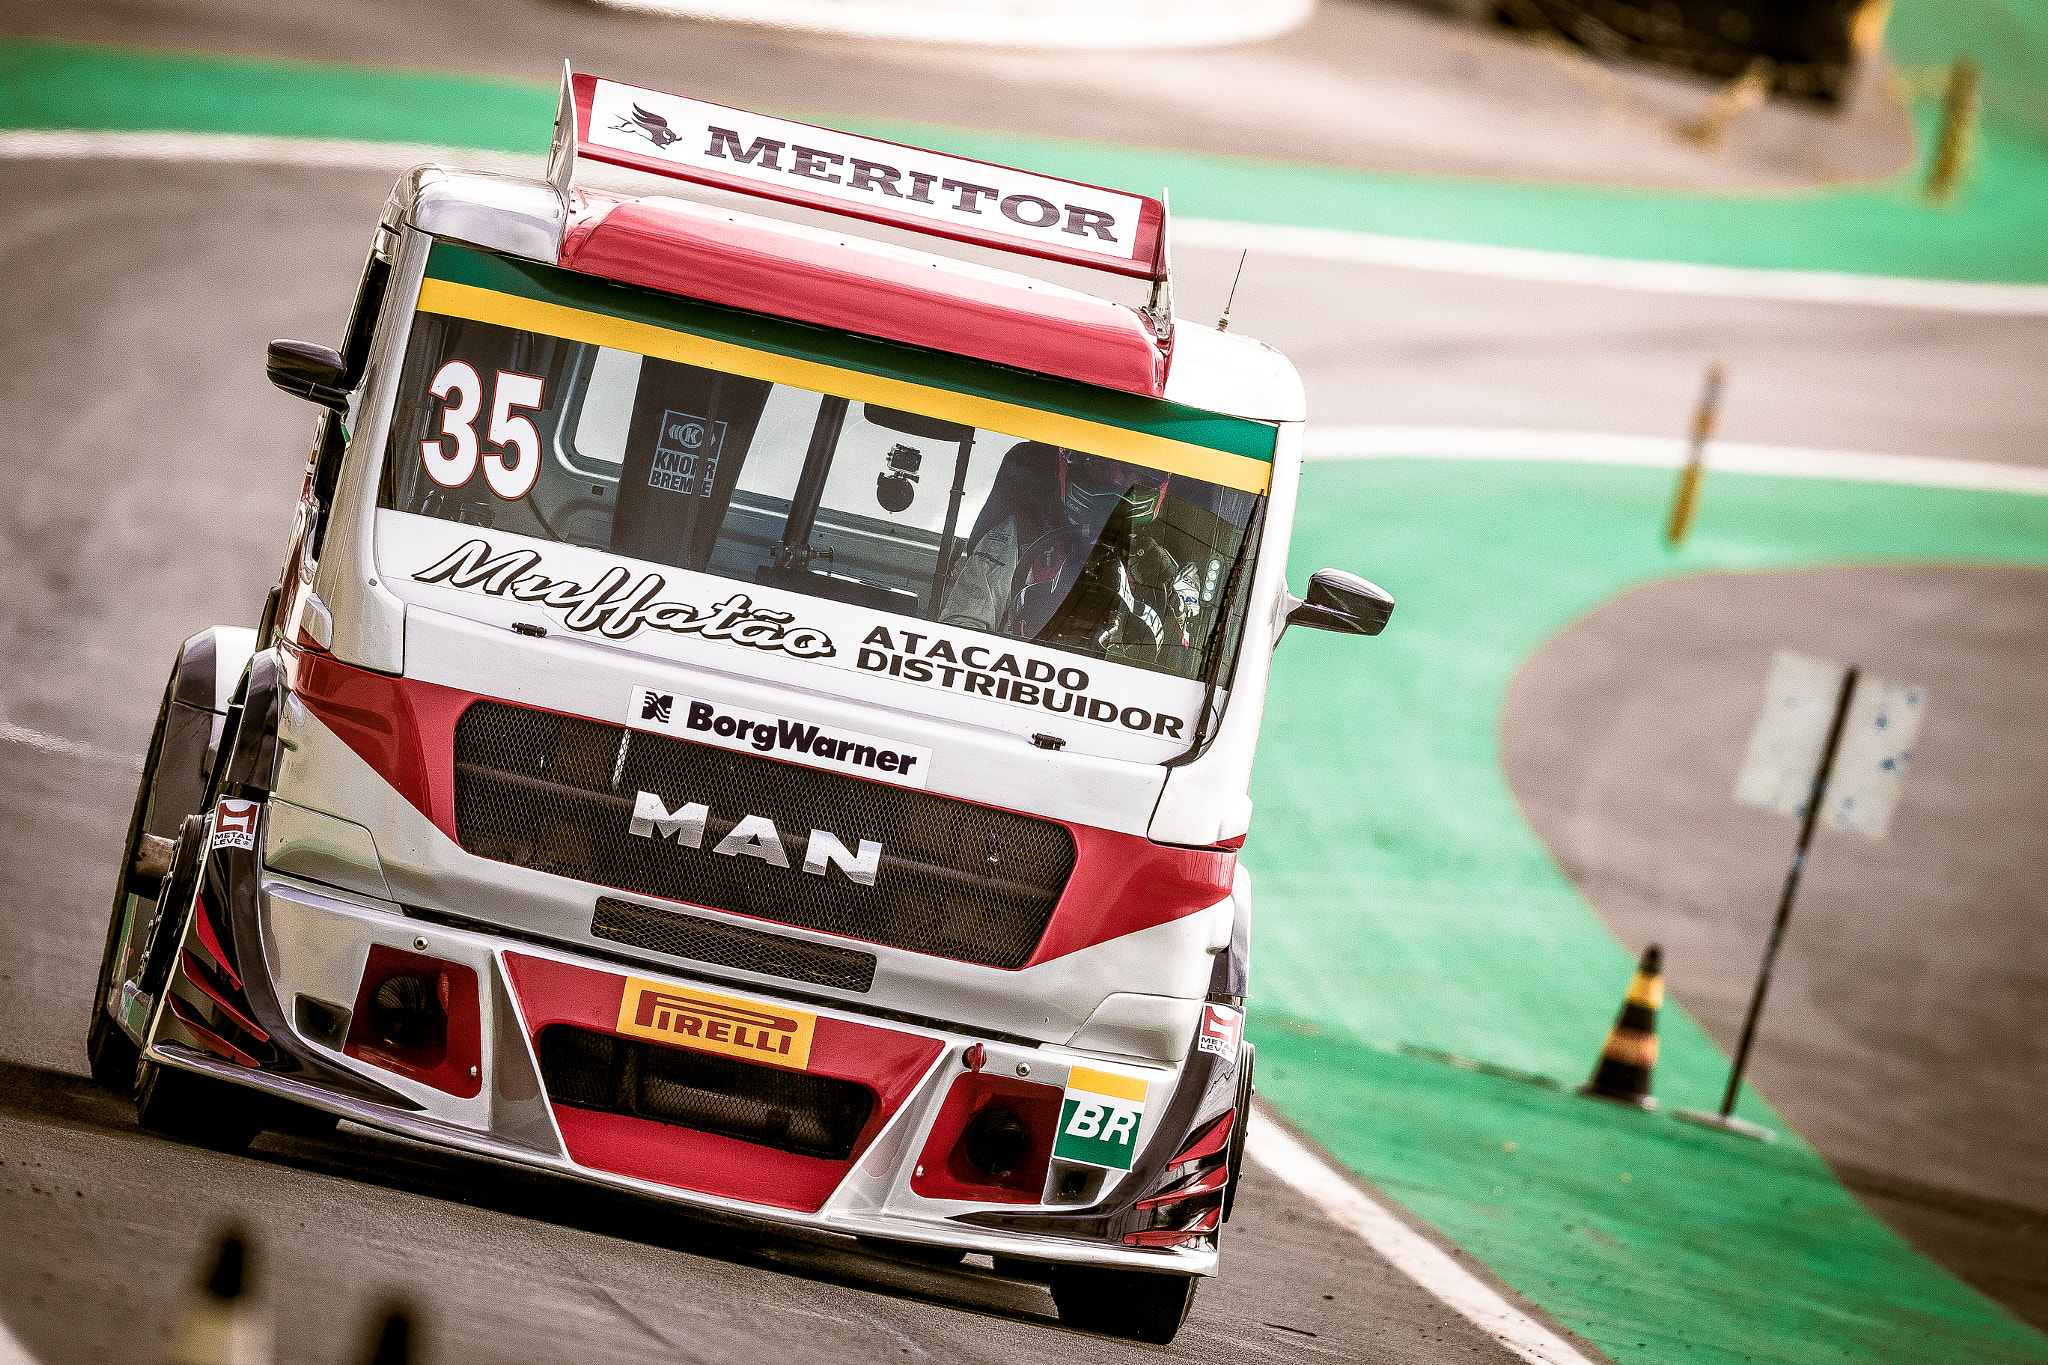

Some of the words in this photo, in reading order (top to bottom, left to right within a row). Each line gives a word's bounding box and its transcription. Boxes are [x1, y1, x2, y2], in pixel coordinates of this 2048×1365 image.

[703, 126, 1117, 242] MERITOR
[420, 360, 546, 500] 35
[650, 470, 713, 496] BREME
[411, 539, 837, 657] Muffatão
[861, 625, 1090, 692] ATACADO
[856, 650, 1186, 739] DISTRIBUIDOR
[686, 701, 917, 776] BorgWarner
[213, 838, 242, 847] LEVE
[214, 832, 252, 841] METAL
[628, 790, 883, 886] MAN
[634, 989, 798, 1055] PIRELLI
[1200, 1043, 1227, 1056] LEVE
[1201, 1037, 1235, 1053] METAL
[1064, 1101, 1137, 1146] BR
